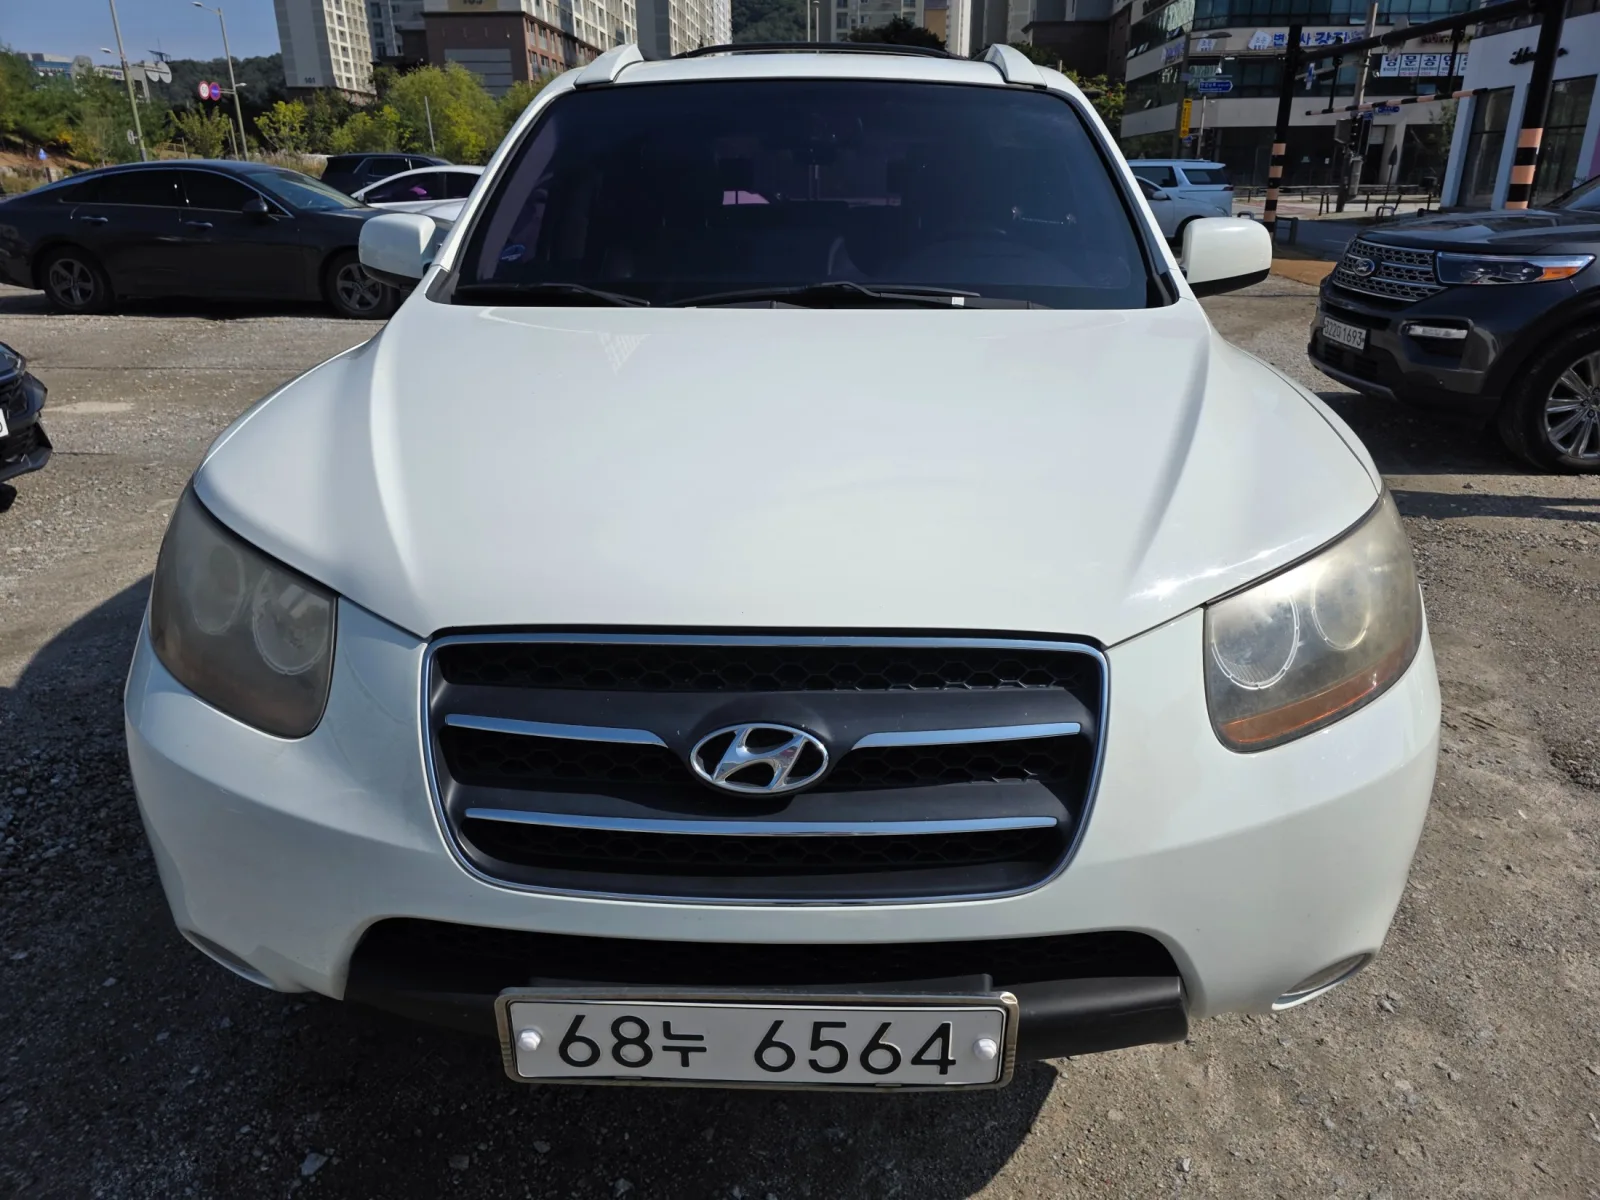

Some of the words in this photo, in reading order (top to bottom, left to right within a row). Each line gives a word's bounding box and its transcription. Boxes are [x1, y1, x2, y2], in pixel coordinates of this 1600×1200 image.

[1273, 33, 1310, 46] 변사
[558, 1014, 707, 1068] 68누
[754, 1020, 957, 1075] 6564
